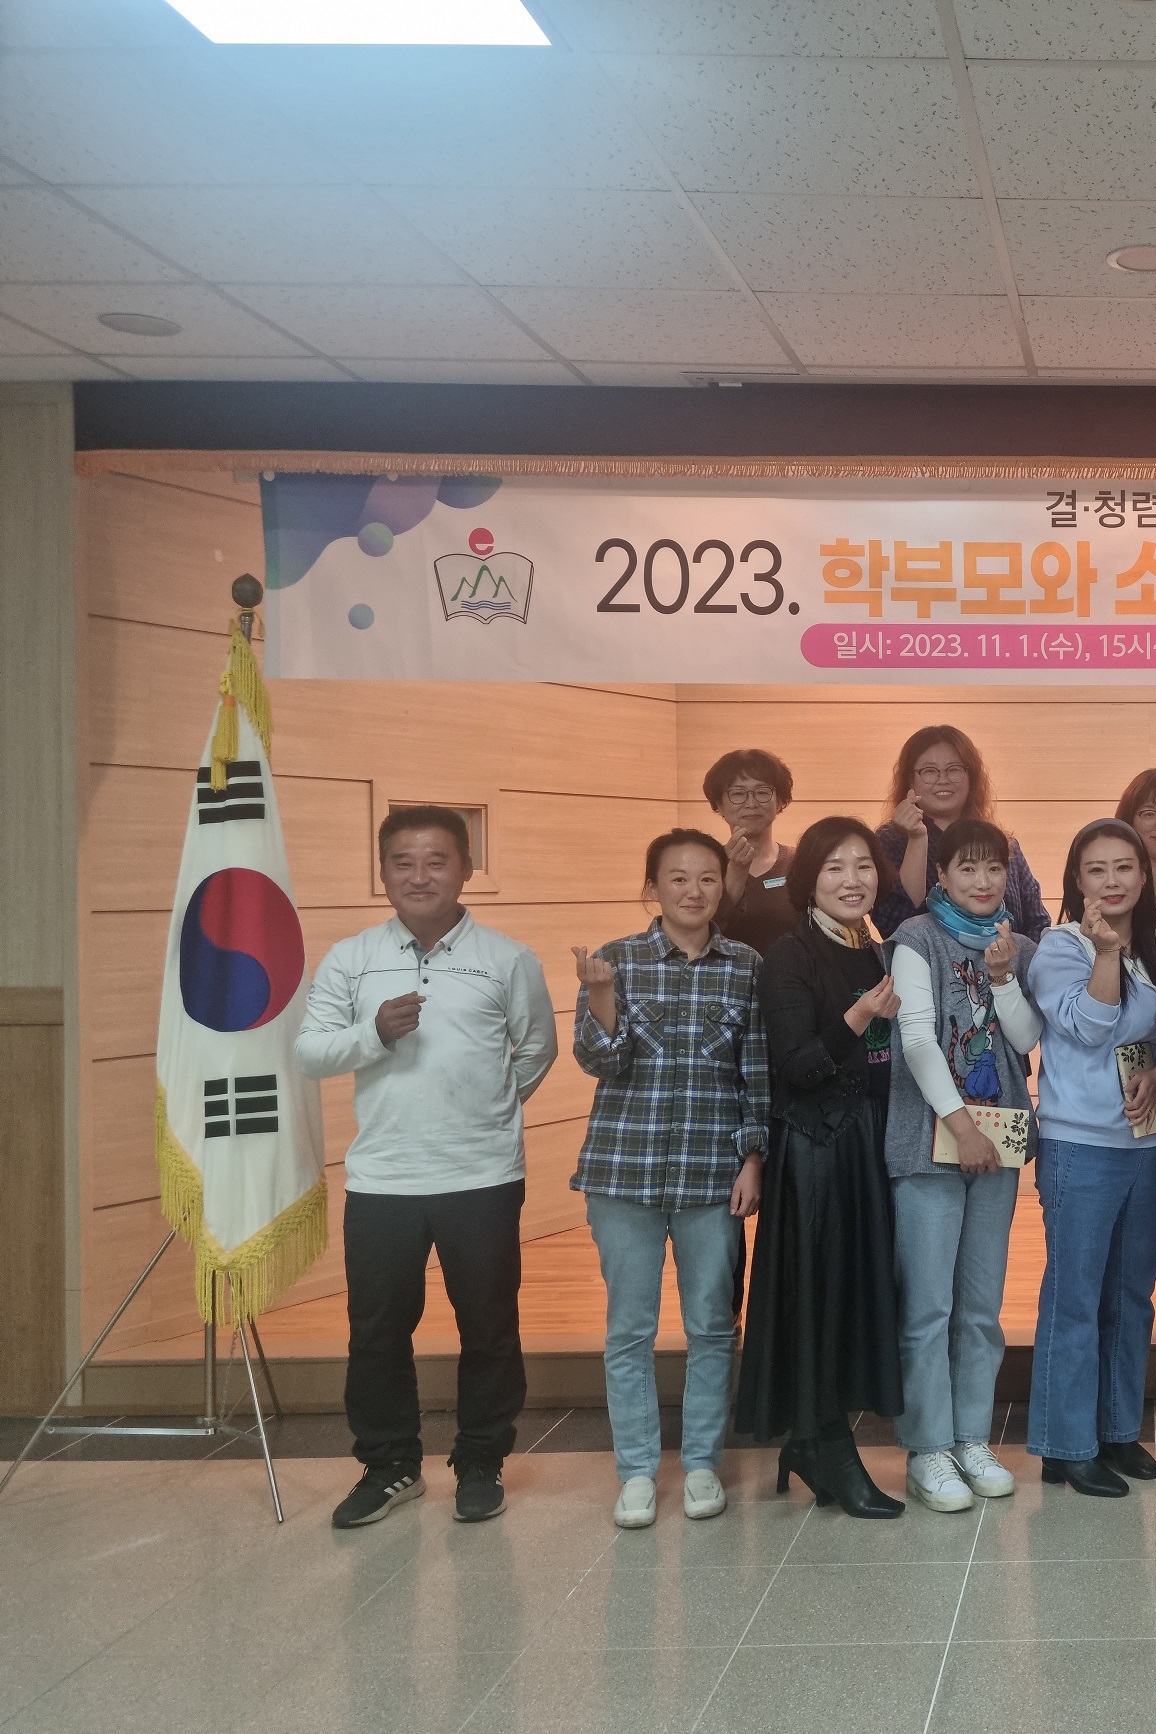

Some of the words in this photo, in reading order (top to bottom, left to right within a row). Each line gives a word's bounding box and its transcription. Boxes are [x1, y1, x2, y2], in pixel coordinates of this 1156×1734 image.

[594, 537, 800, 616] 2023.
[819, 537, 1098, 618] 학부모와
[833, 631, 892, 659] 일시:
[899, 633, 970, 657] 2023.
[977, 633, 1011, 657] 11.
